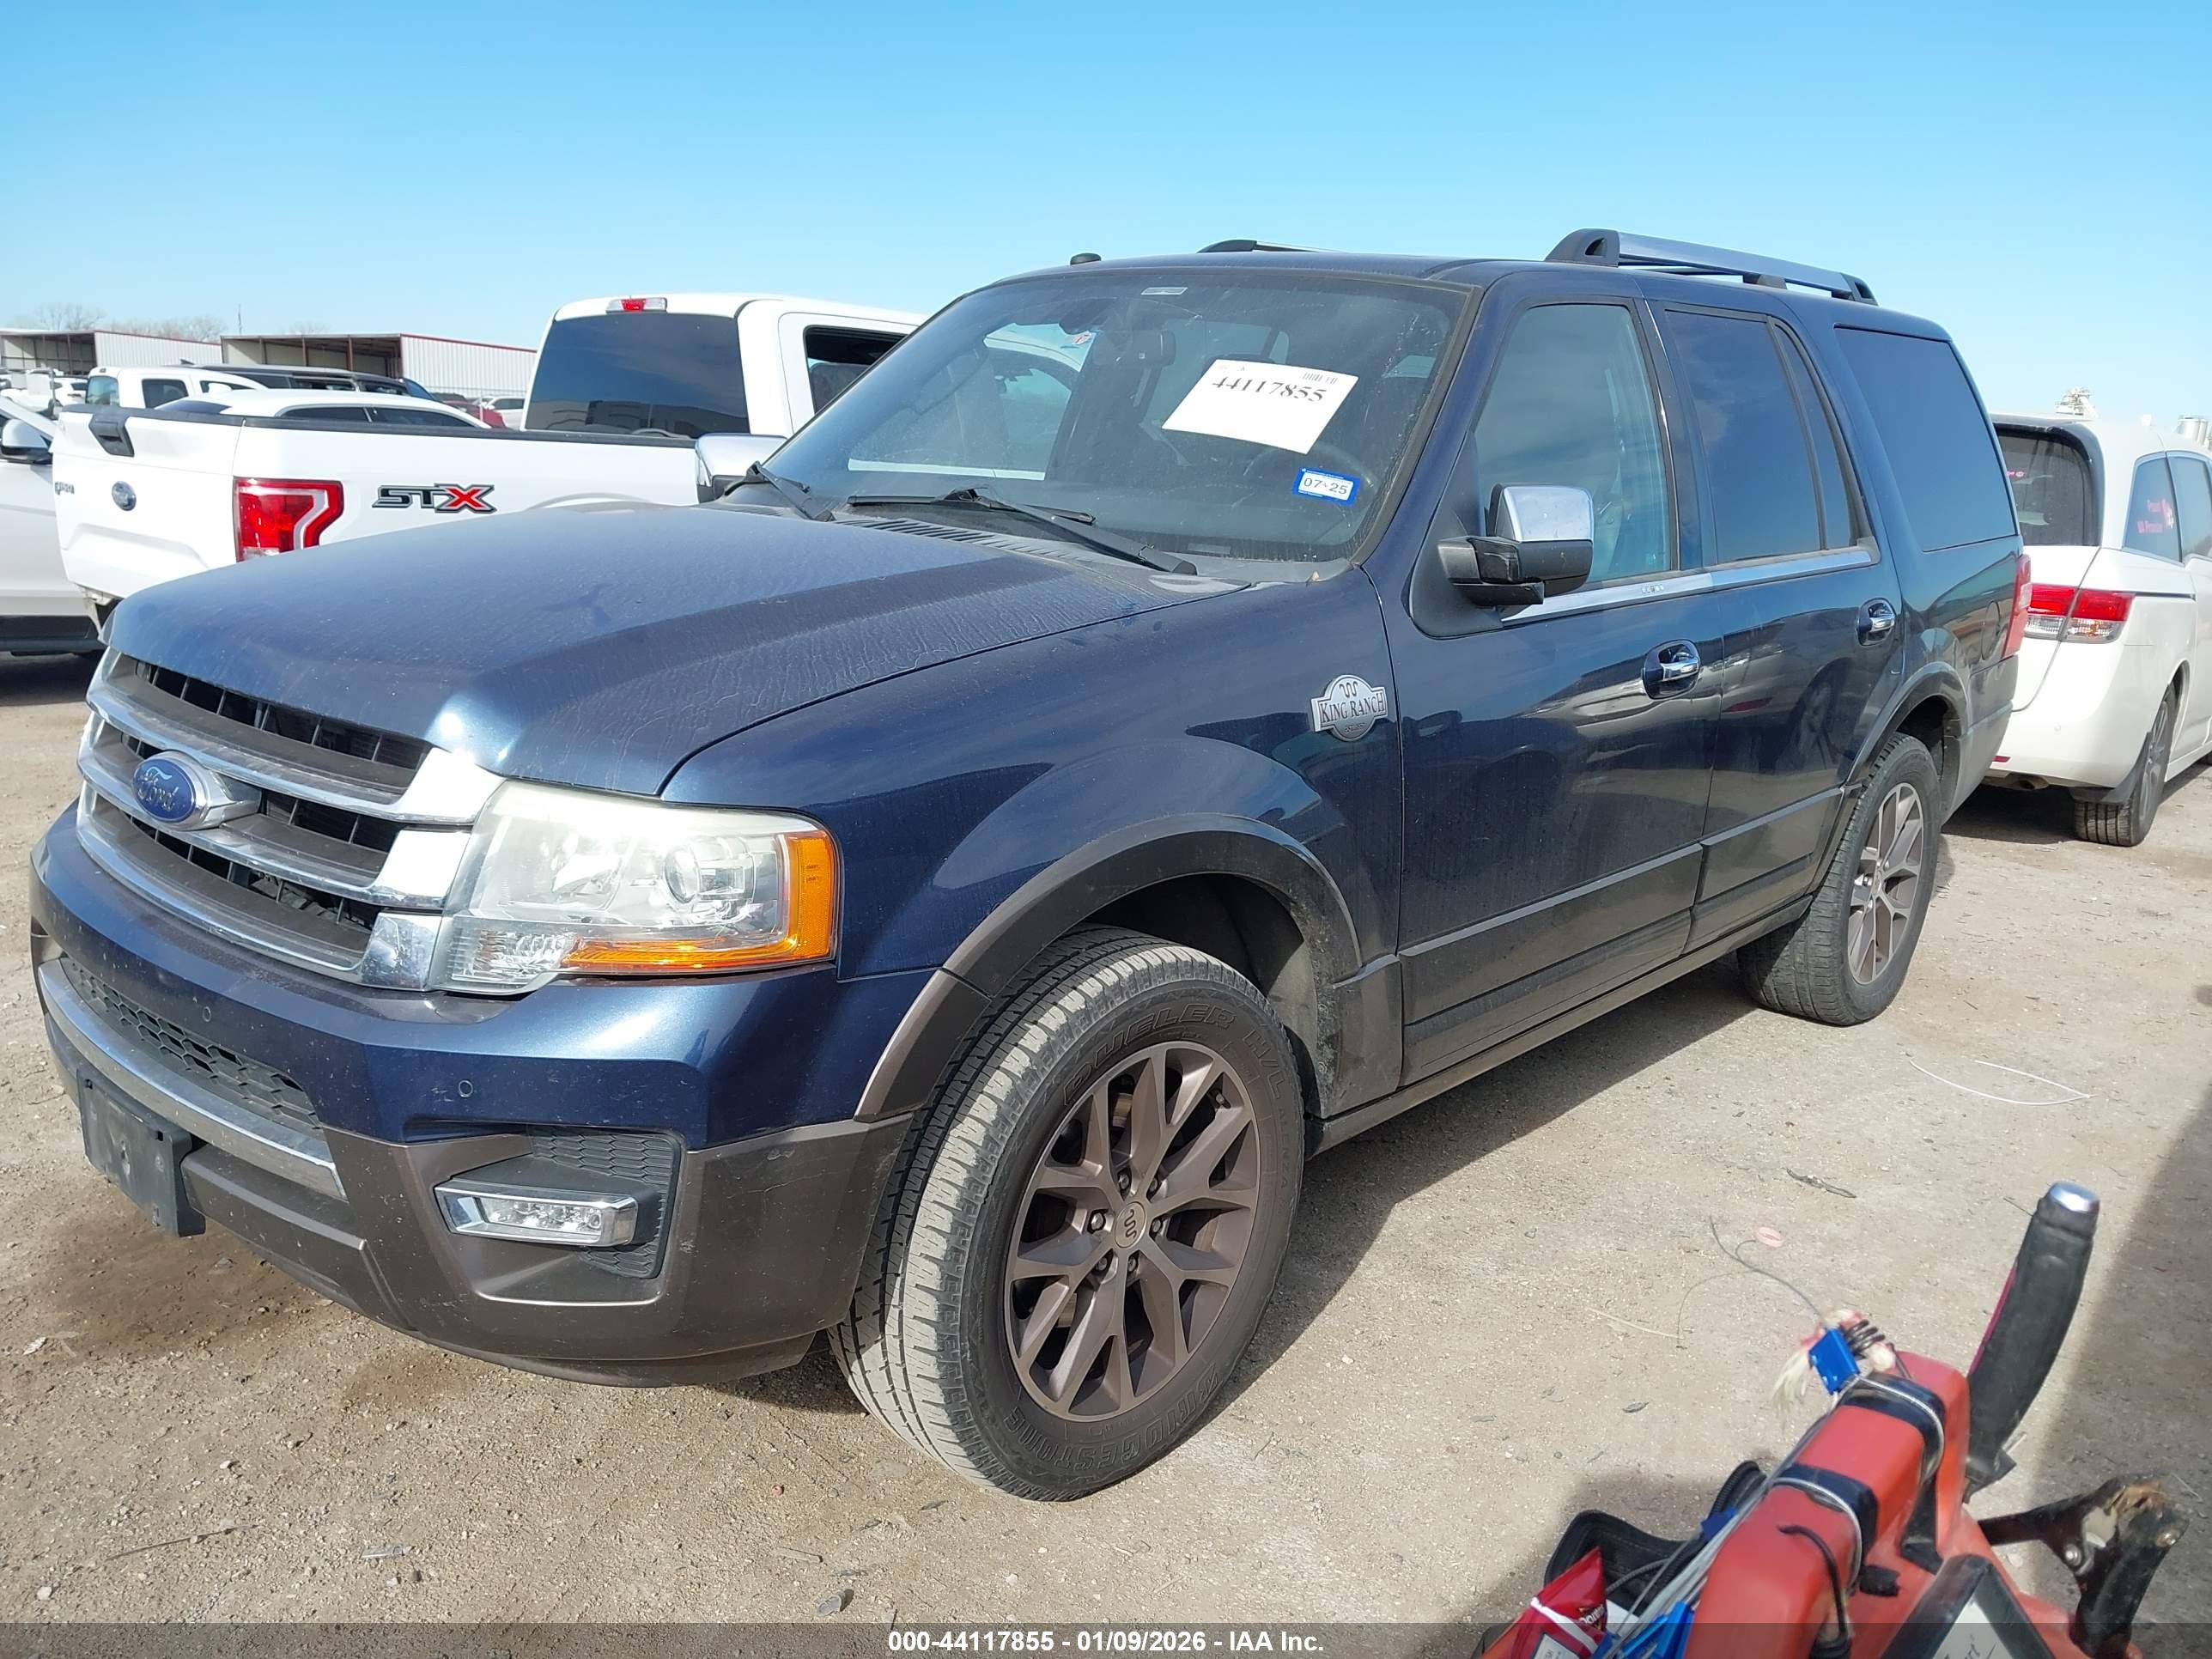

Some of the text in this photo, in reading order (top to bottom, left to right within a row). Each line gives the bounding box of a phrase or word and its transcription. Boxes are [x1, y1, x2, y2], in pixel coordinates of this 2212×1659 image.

[1212, 376, 1327, 402] 44117855
[372, 483, 497, 514] STX
[1304, 477, 1322, 489] 07
[1328, 482, 1347, 495] 25
[1319, 691, 1384, 723] KING RANCH
[137, 766, 179, 812] Ford
[1002, 1364, 1223, 1470] BRIDGESTONE
